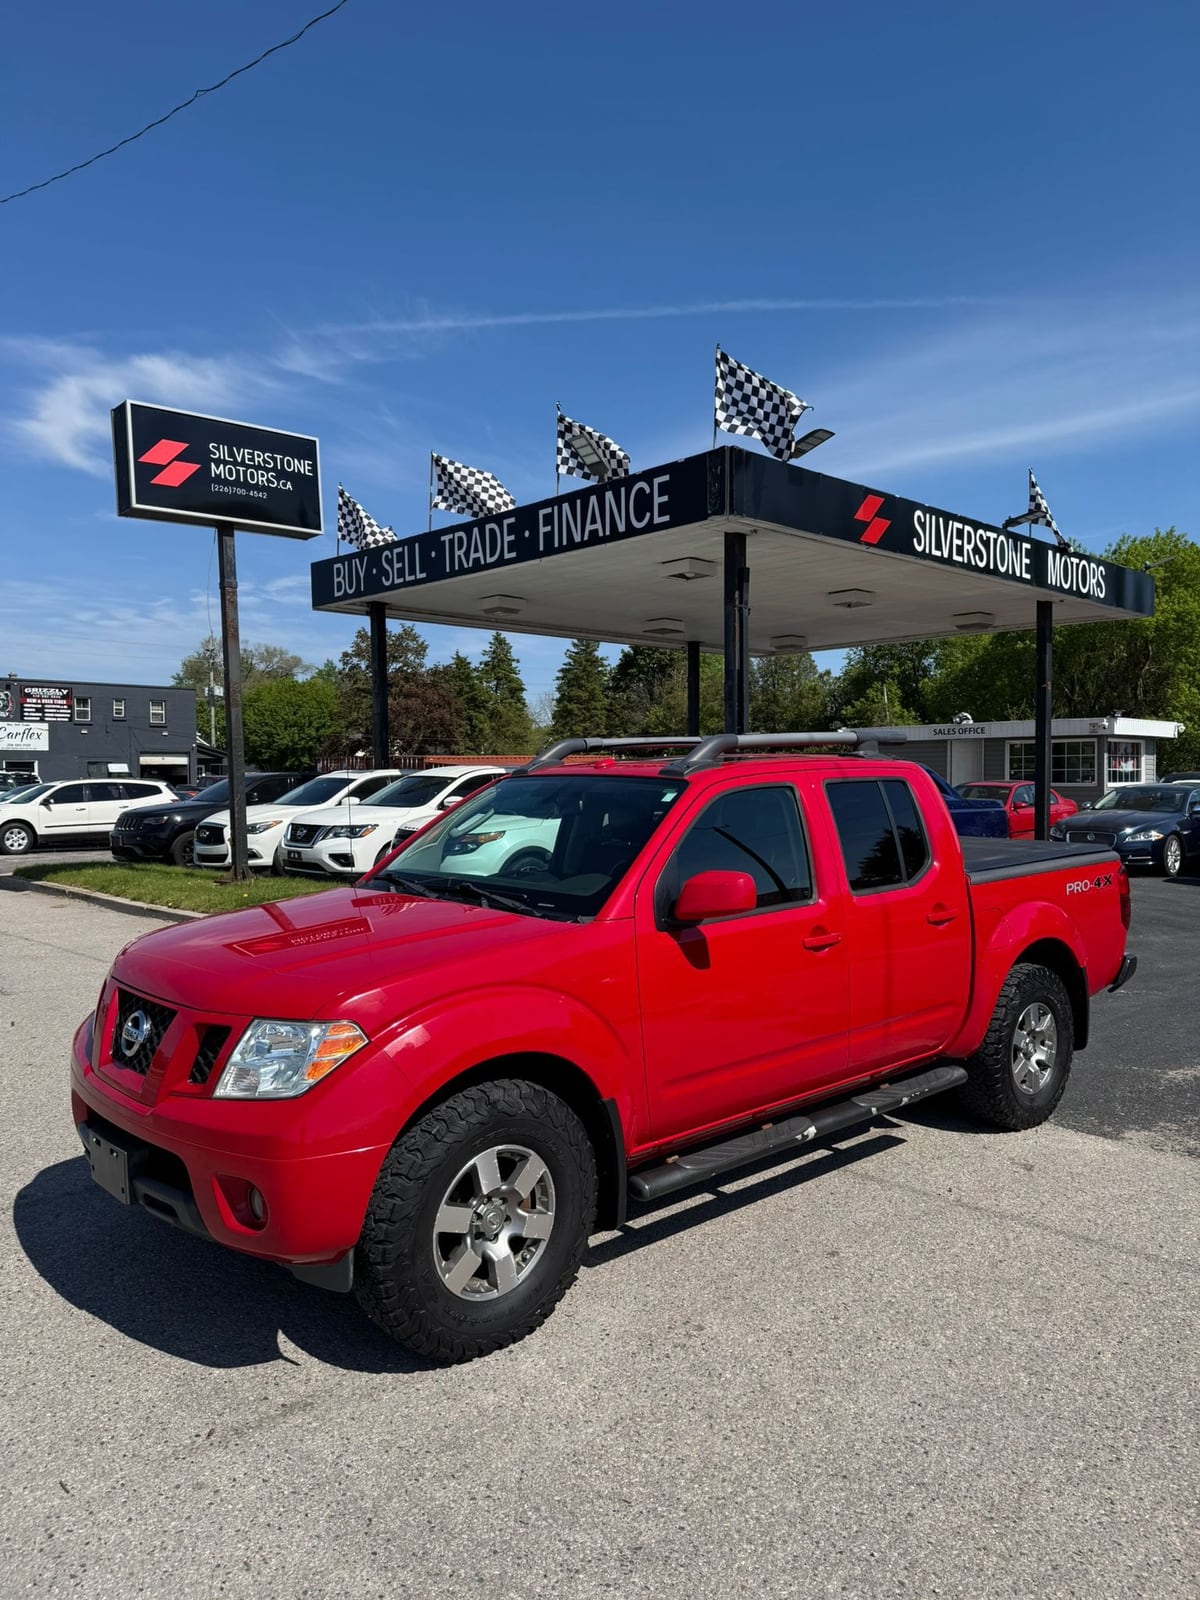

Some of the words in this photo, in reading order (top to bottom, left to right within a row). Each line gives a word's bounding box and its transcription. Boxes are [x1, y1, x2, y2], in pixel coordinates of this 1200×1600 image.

[208, 442, 314, 477] SILVERSTONE
[210, 462, 293, 491] MOTORS.CA
[211, 484, 268, 499] (226)700-4542
[333, 556, 368, 598] BUY
[381, 543, 427, 587] SELL
[440, 517, 517, 573] TRADE
[538, 474, 671, 552] FINANCE
[912, 509, 1032, 580] SILVERSTONE
[1047, 550, 1106, 599] MOTORS
[24, 687, 68, 695] GRIZZLY
[933, 728, 957, 736] SALES
[957, 726, 986, 735] OFFICE
[1066, 873, 1113, 896] PRO-4X
